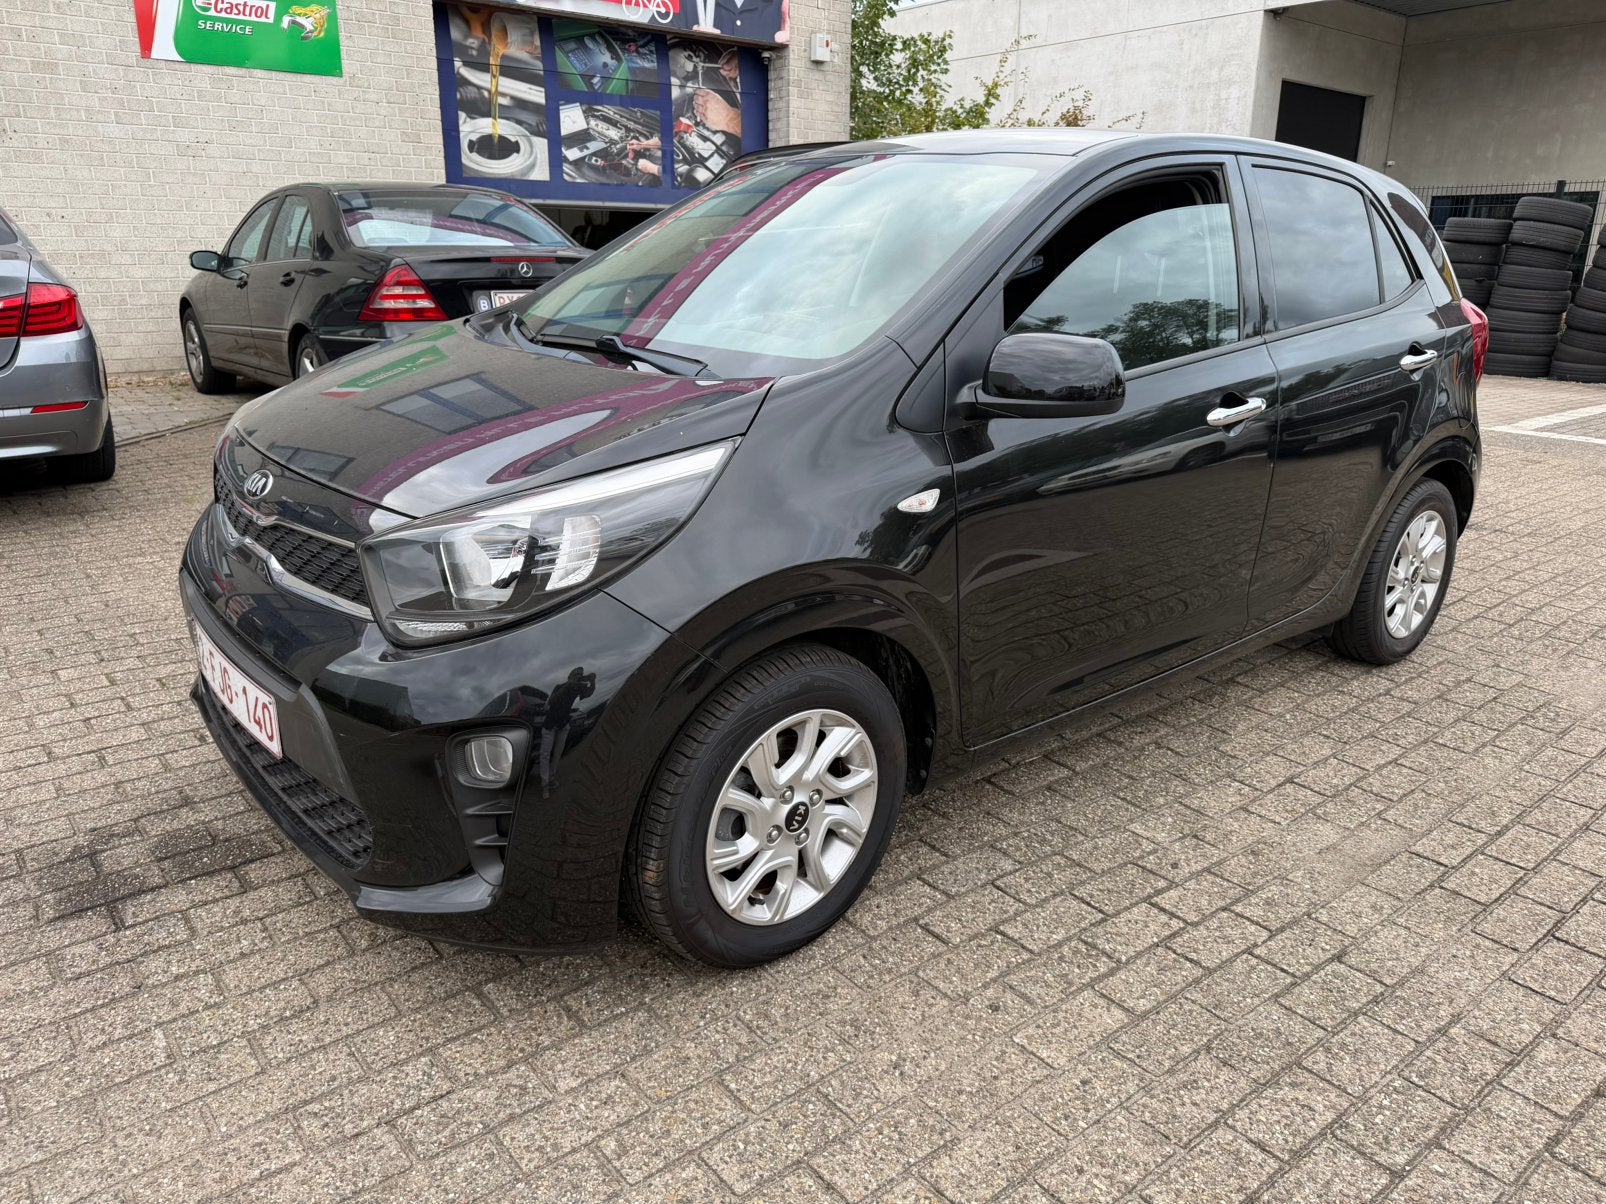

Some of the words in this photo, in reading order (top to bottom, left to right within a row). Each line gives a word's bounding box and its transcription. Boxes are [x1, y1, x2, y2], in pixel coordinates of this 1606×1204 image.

[213, 0, 271, 19] Castrol
[197, 20, 253, 35] SERVICE
[480, 299, 489, 311] B
[247, 472, 267, 495] KIA
[790, 805, 806, 830] KIA
